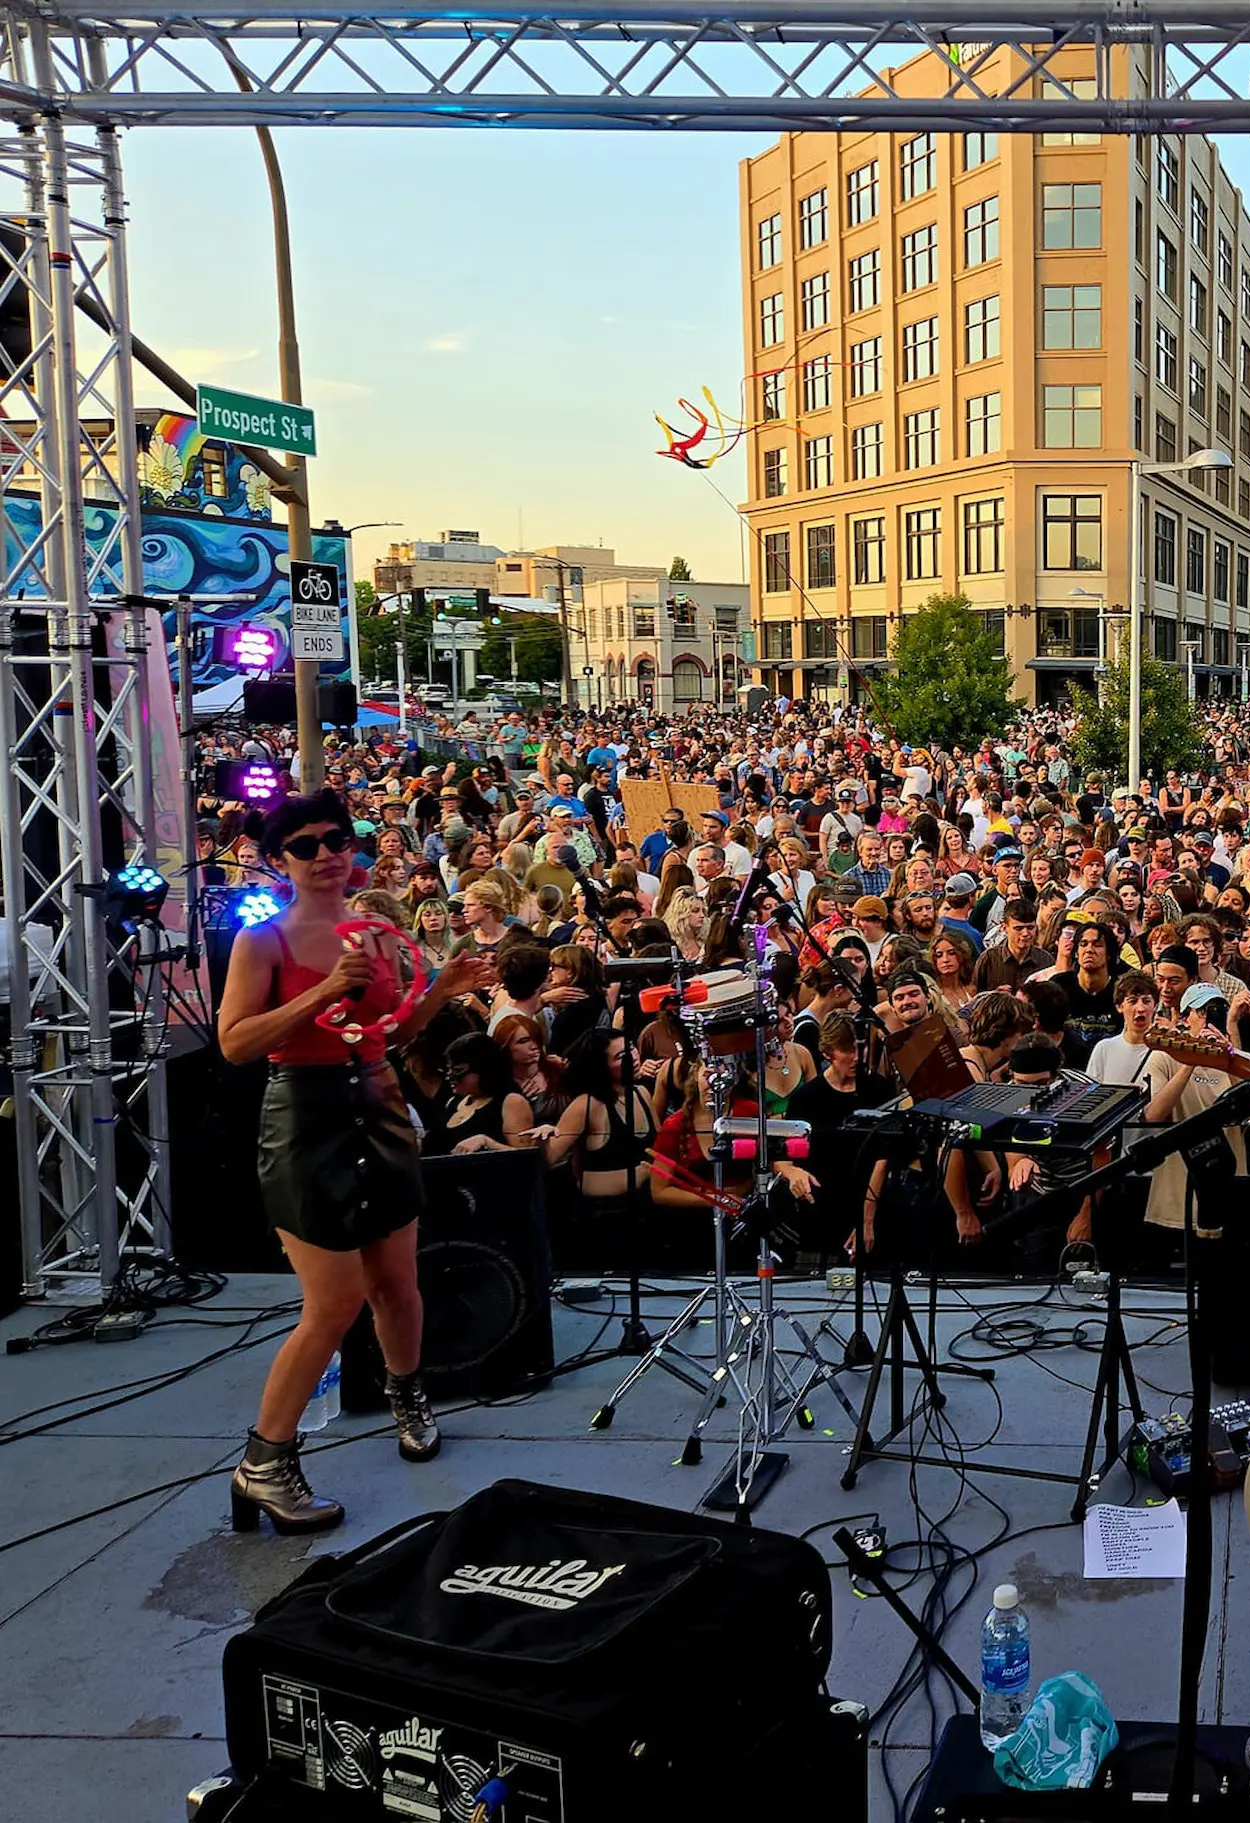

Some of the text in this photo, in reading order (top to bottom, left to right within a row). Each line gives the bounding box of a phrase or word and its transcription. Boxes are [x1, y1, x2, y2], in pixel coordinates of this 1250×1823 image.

[201, 397, 299, 441] Prospect St
[296, 607, 338, 622] BIKE LANE
[303, 637, 333, 652] ENDS
[440, 1559, 627, 1601] aguilar
[379, 1716, 445, 1760] aguilar
